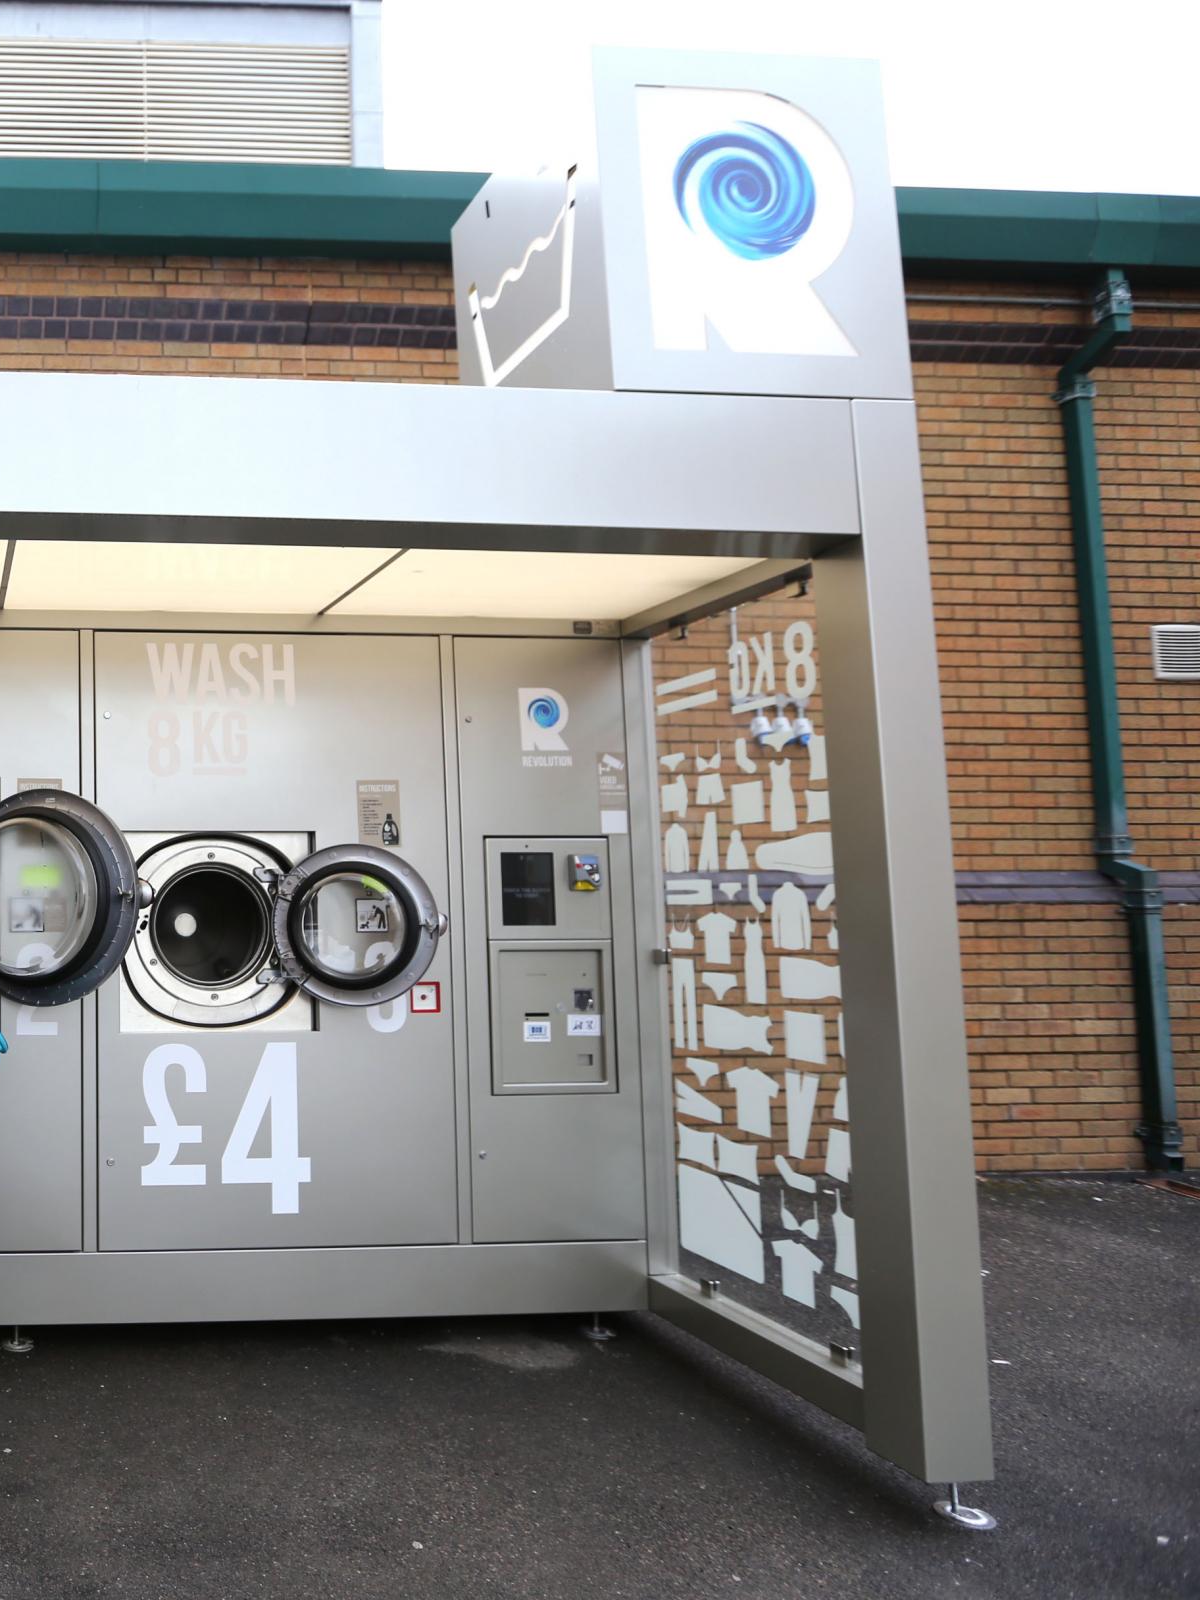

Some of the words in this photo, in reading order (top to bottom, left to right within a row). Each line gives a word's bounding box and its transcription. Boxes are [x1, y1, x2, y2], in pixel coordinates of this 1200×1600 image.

[633, 84, 861, 357] R
[145, 642, 297, 706] WASH
[147, 710, 181, 777] 8
[192, 711, 249, 764] KG
[518, 687, 569, 751] R
[522, 755, 573, 767] REVOLUTION
[141, 1041, 312, 1215] £4
